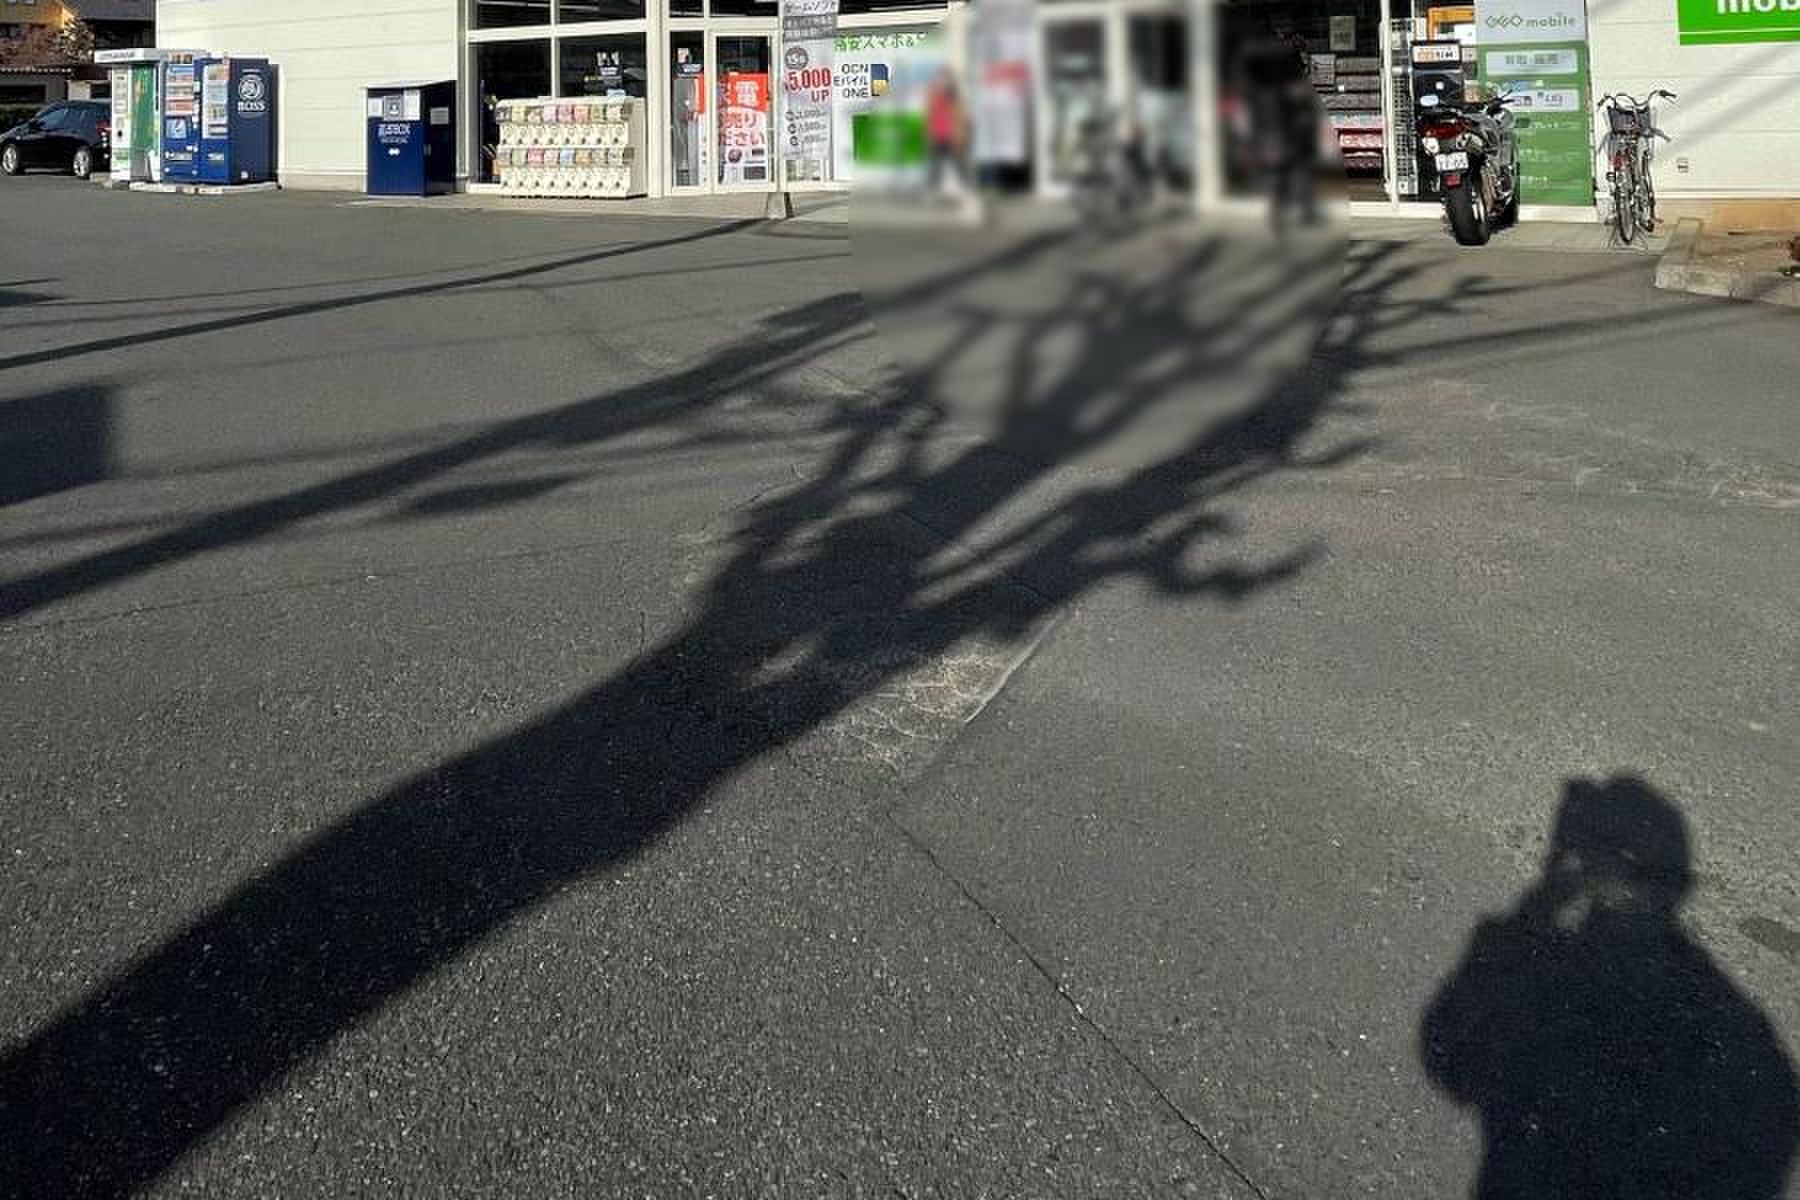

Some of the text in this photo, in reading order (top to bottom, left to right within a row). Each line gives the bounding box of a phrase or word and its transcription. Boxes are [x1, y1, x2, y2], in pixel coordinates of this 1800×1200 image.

[1525, 13, 1576, 28] mobile
[841, 63, 869, 74] OCN
[811, 89, 830, 103] UP
[841, 87, 869, 98] ONE
[237, 100, 266, 112] BOSS
